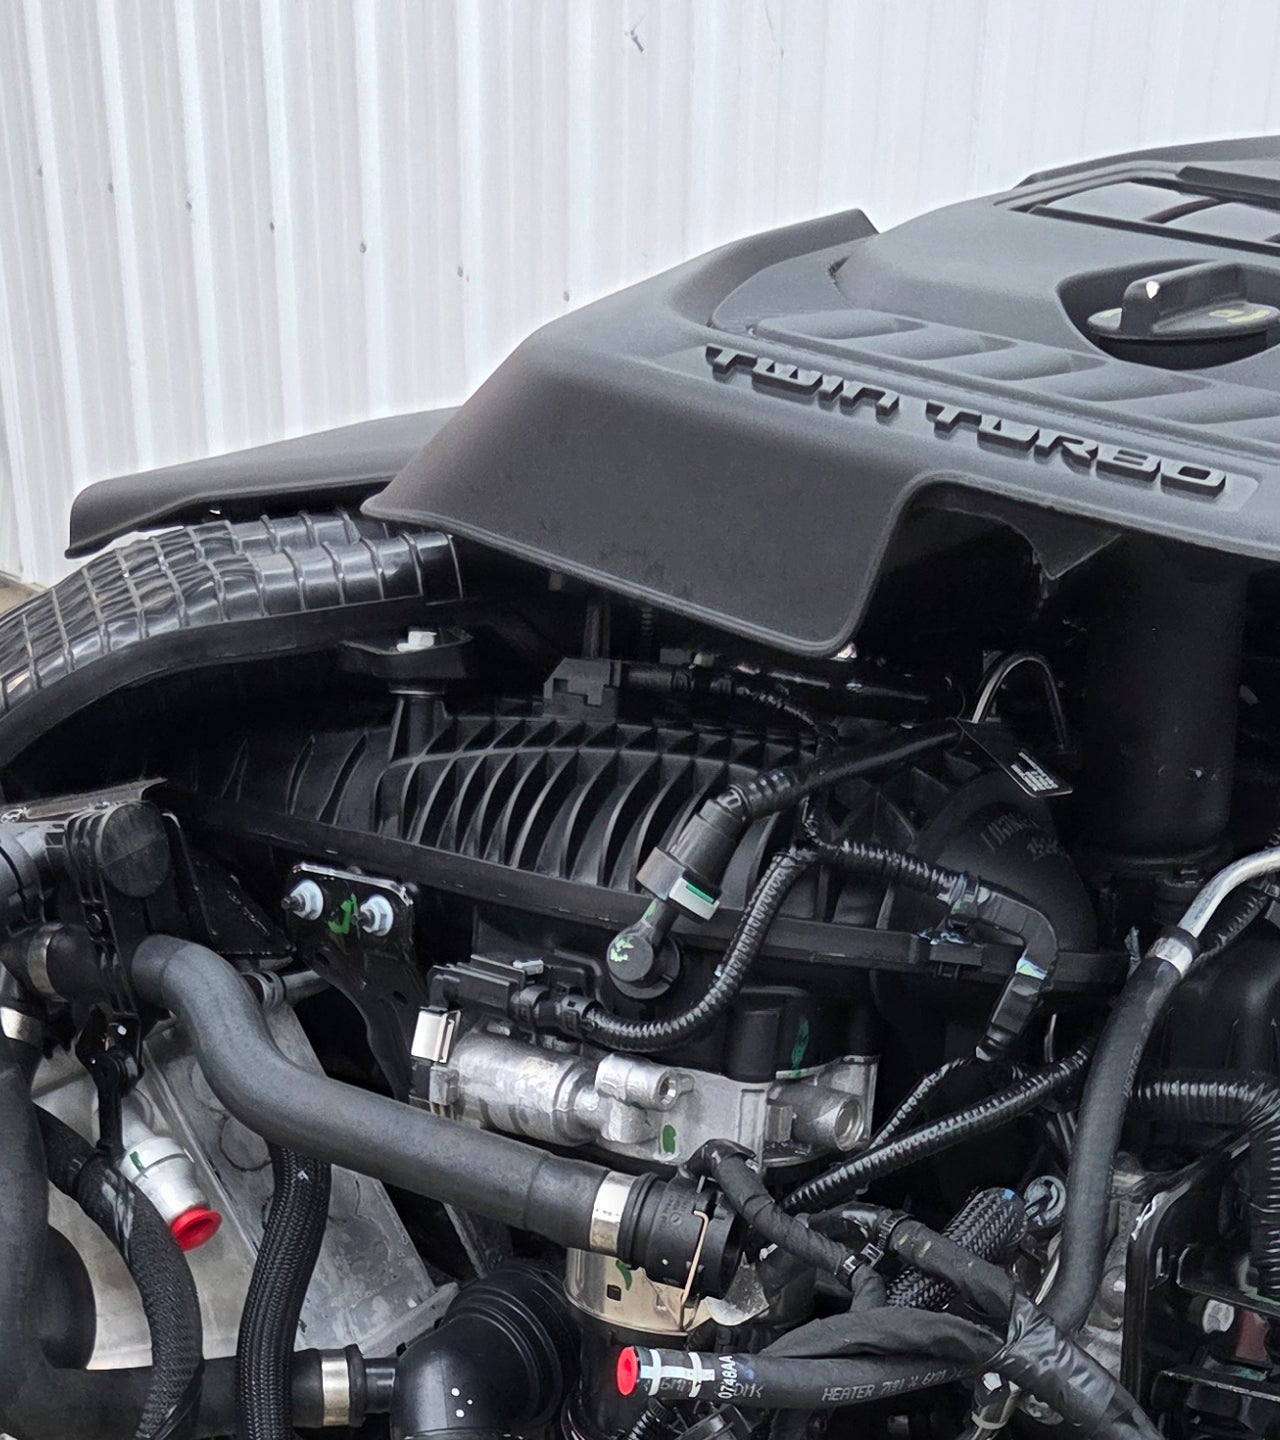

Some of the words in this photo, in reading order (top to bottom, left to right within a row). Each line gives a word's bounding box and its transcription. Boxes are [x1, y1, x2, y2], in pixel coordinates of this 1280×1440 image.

[705, 344, 900, 415] TWIN
[925, 401, 1227, 497] TURBO
[822, 1384, 875, 1401] HEATER
